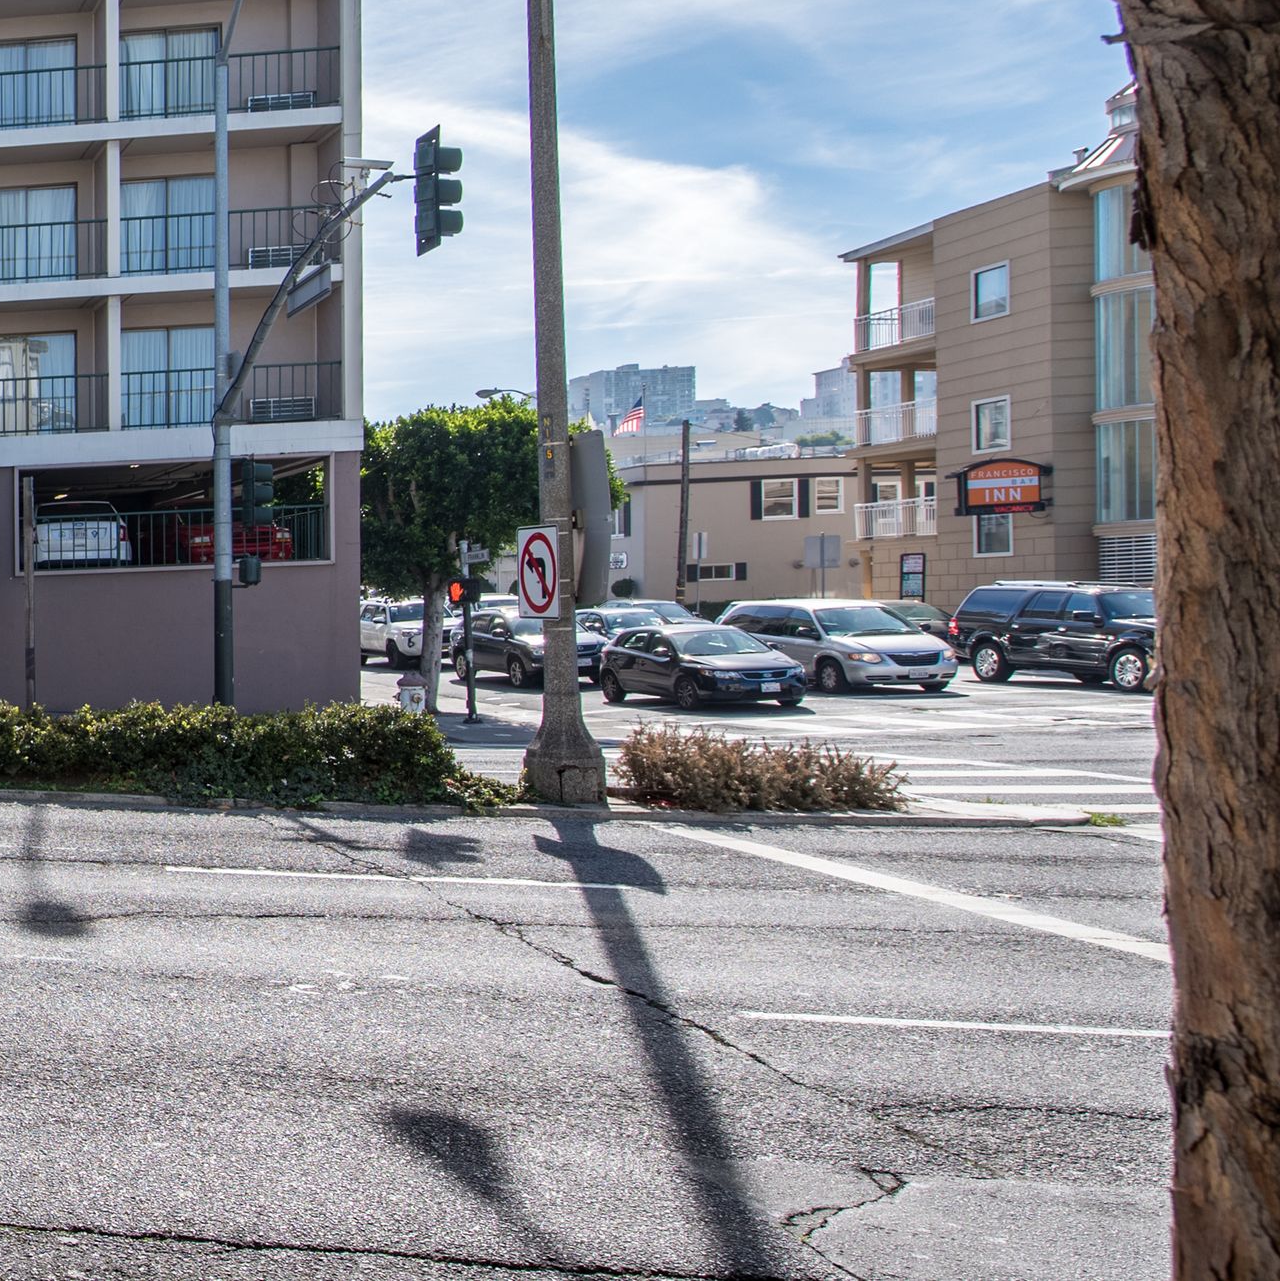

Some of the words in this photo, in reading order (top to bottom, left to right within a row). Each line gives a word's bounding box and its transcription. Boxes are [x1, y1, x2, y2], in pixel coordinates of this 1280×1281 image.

[970, 468, 1034, 479] FRANCISCO
[1011, 478, 1034, 486] BAY
[985, 487, 1022, 503] INN
[993, 504, 1035, 513] VACANCY
